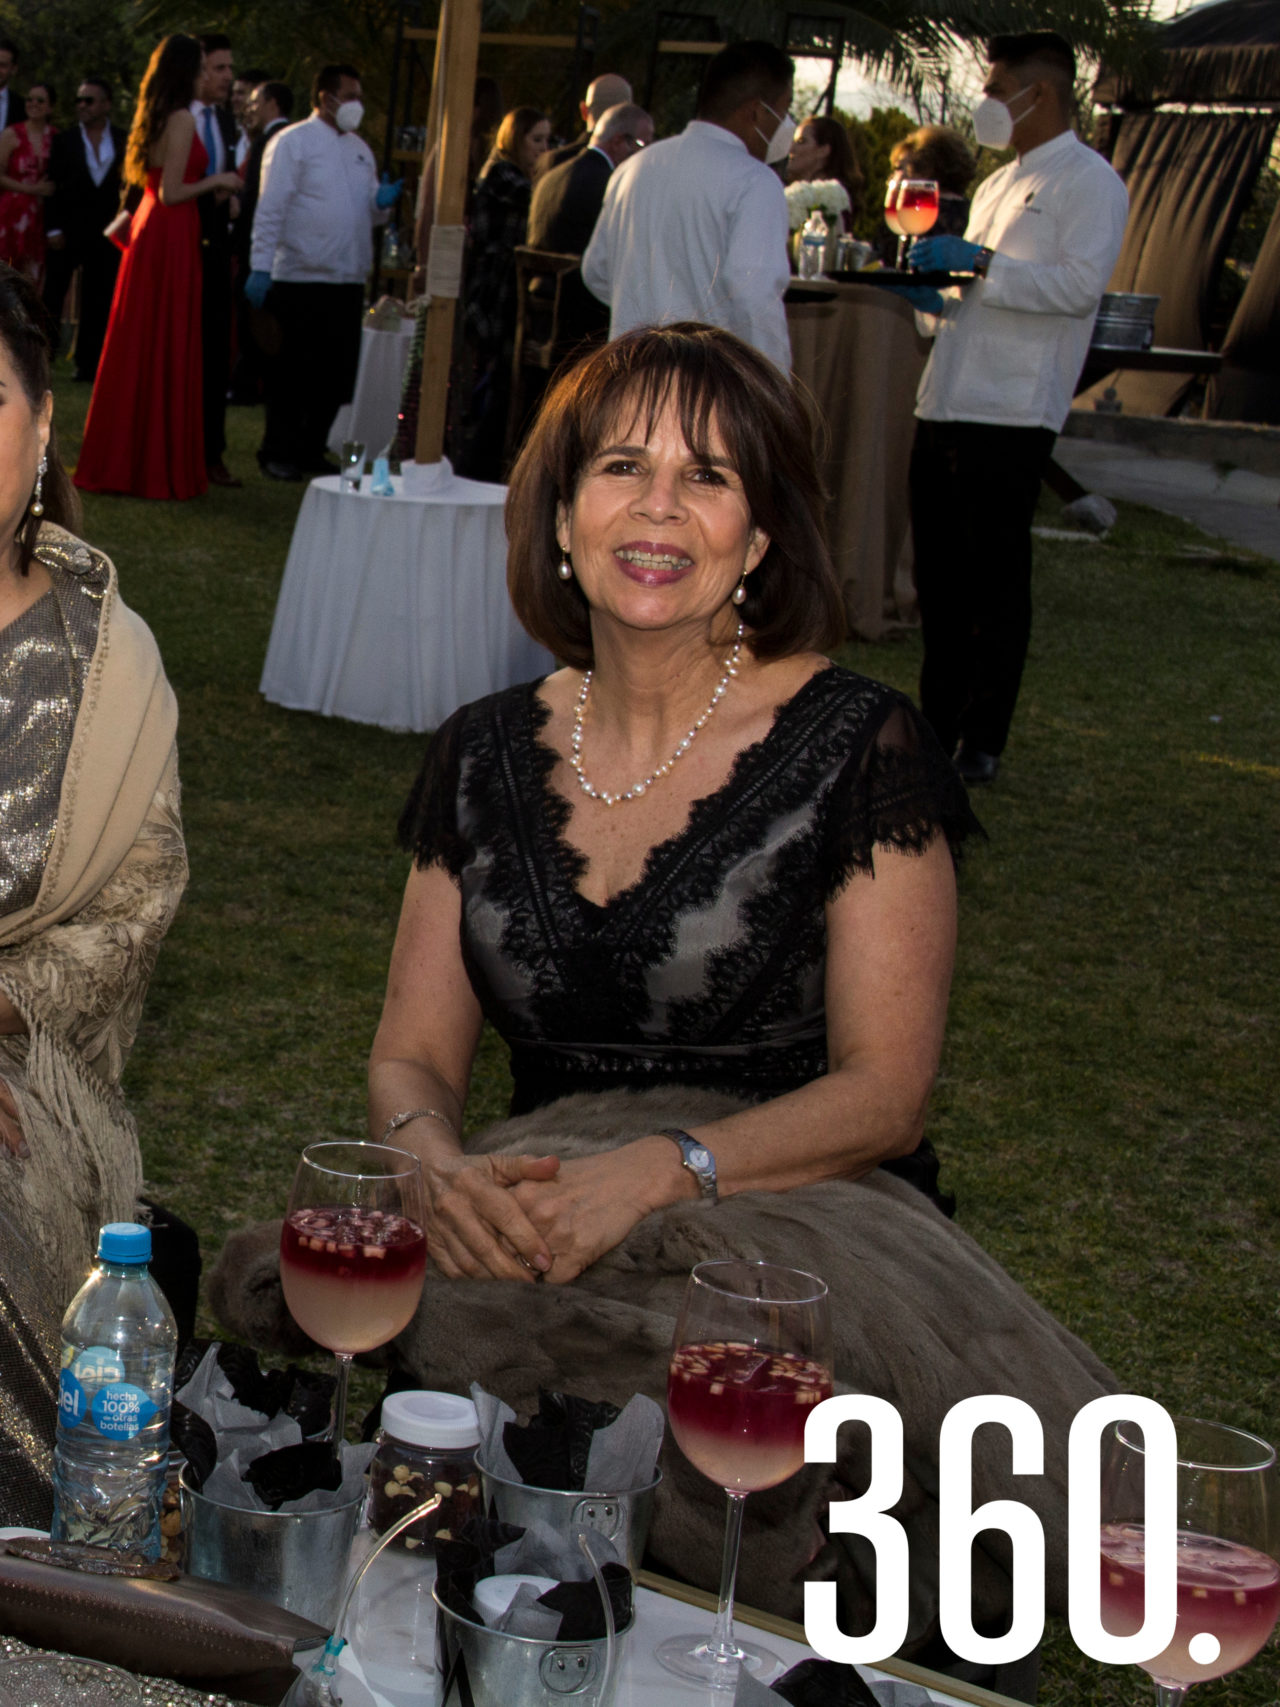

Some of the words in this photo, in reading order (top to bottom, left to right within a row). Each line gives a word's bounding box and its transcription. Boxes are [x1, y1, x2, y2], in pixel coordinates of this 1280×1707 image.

[58, 1378, 80, 1417] iel
[106, 1390, 138, 1401] hecha
[101, 1401, 141, 1413] 100%
[112, 1413, 138, 1422] otras
[99, 1420, 140, 1432] botellas
